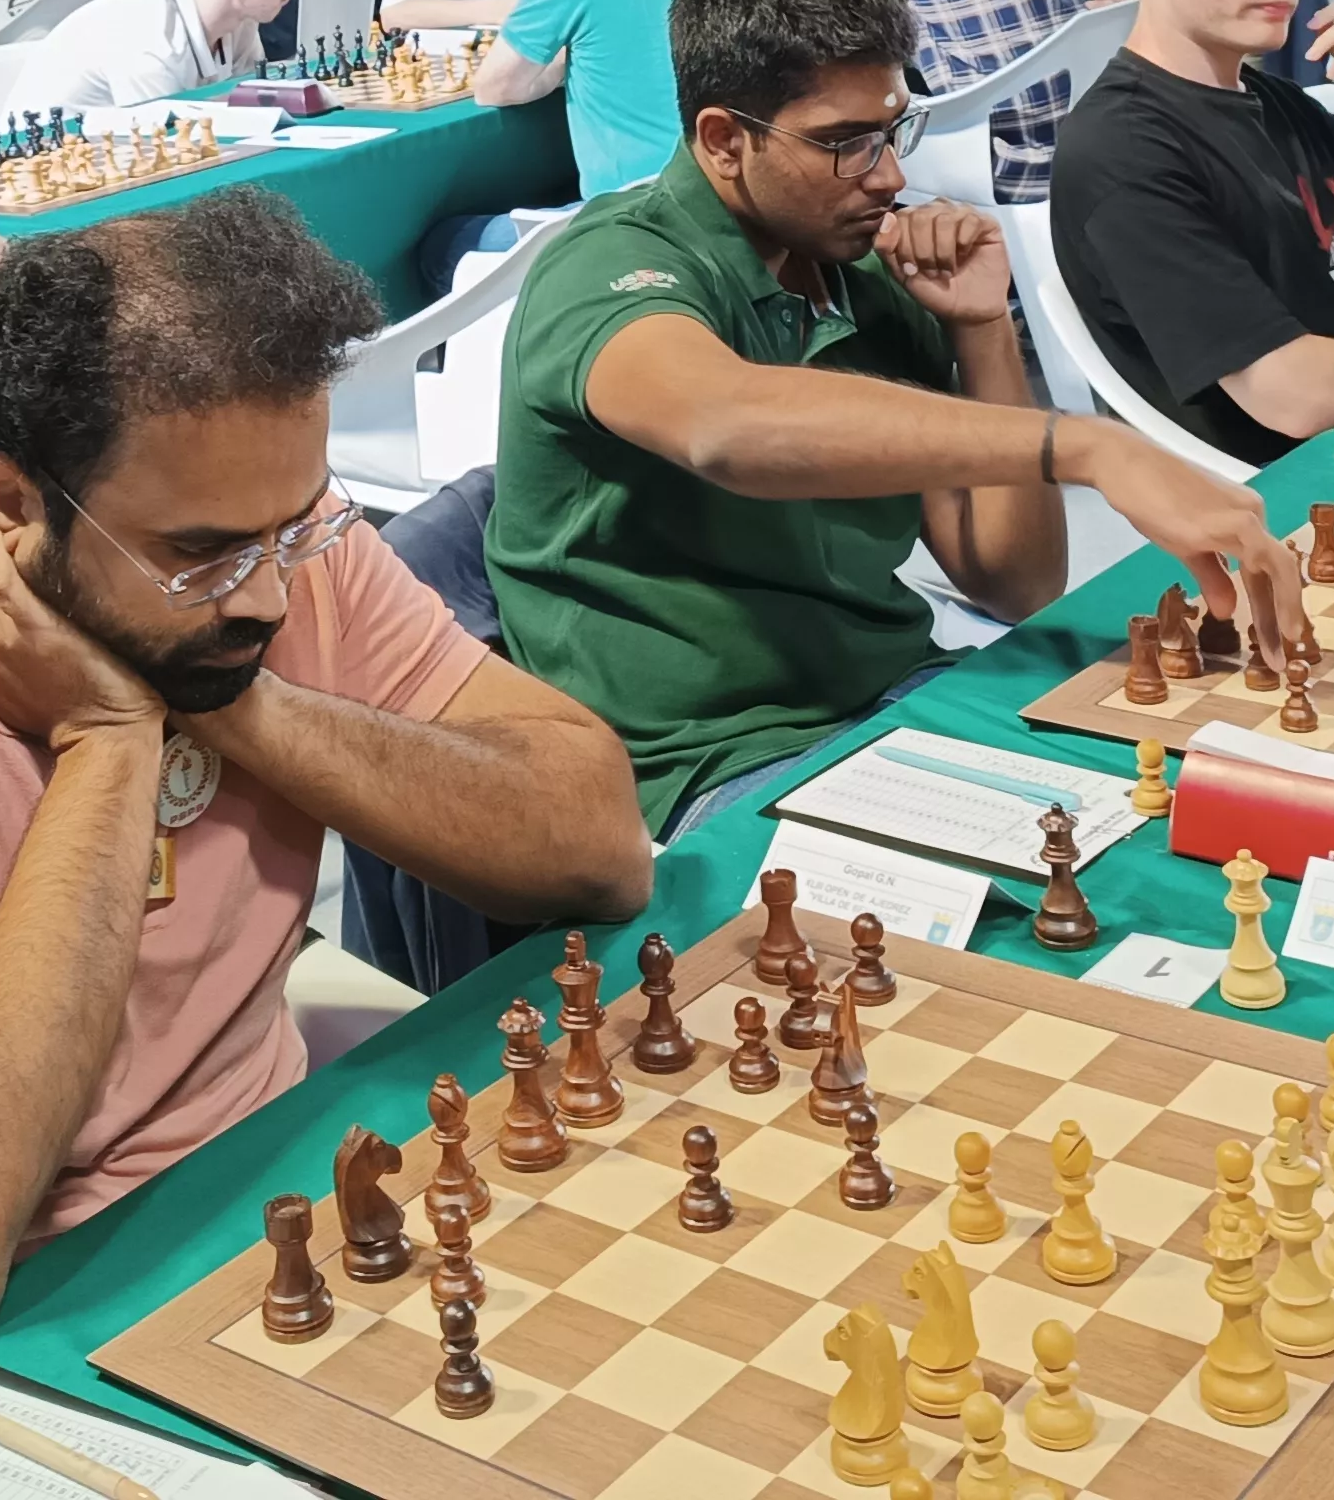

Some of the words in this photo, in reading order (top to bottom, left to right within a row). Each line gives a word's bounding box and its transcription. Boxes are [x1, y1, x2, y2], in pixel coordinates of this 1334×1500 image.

[843, 864, 874, 885] Gopal
[824, 882, 850, 898] OPEN
[853, 891, 865, 902] DE
[869, 895, 912, 916] AJEDREZ
[837, 898, 852, 911] DE
